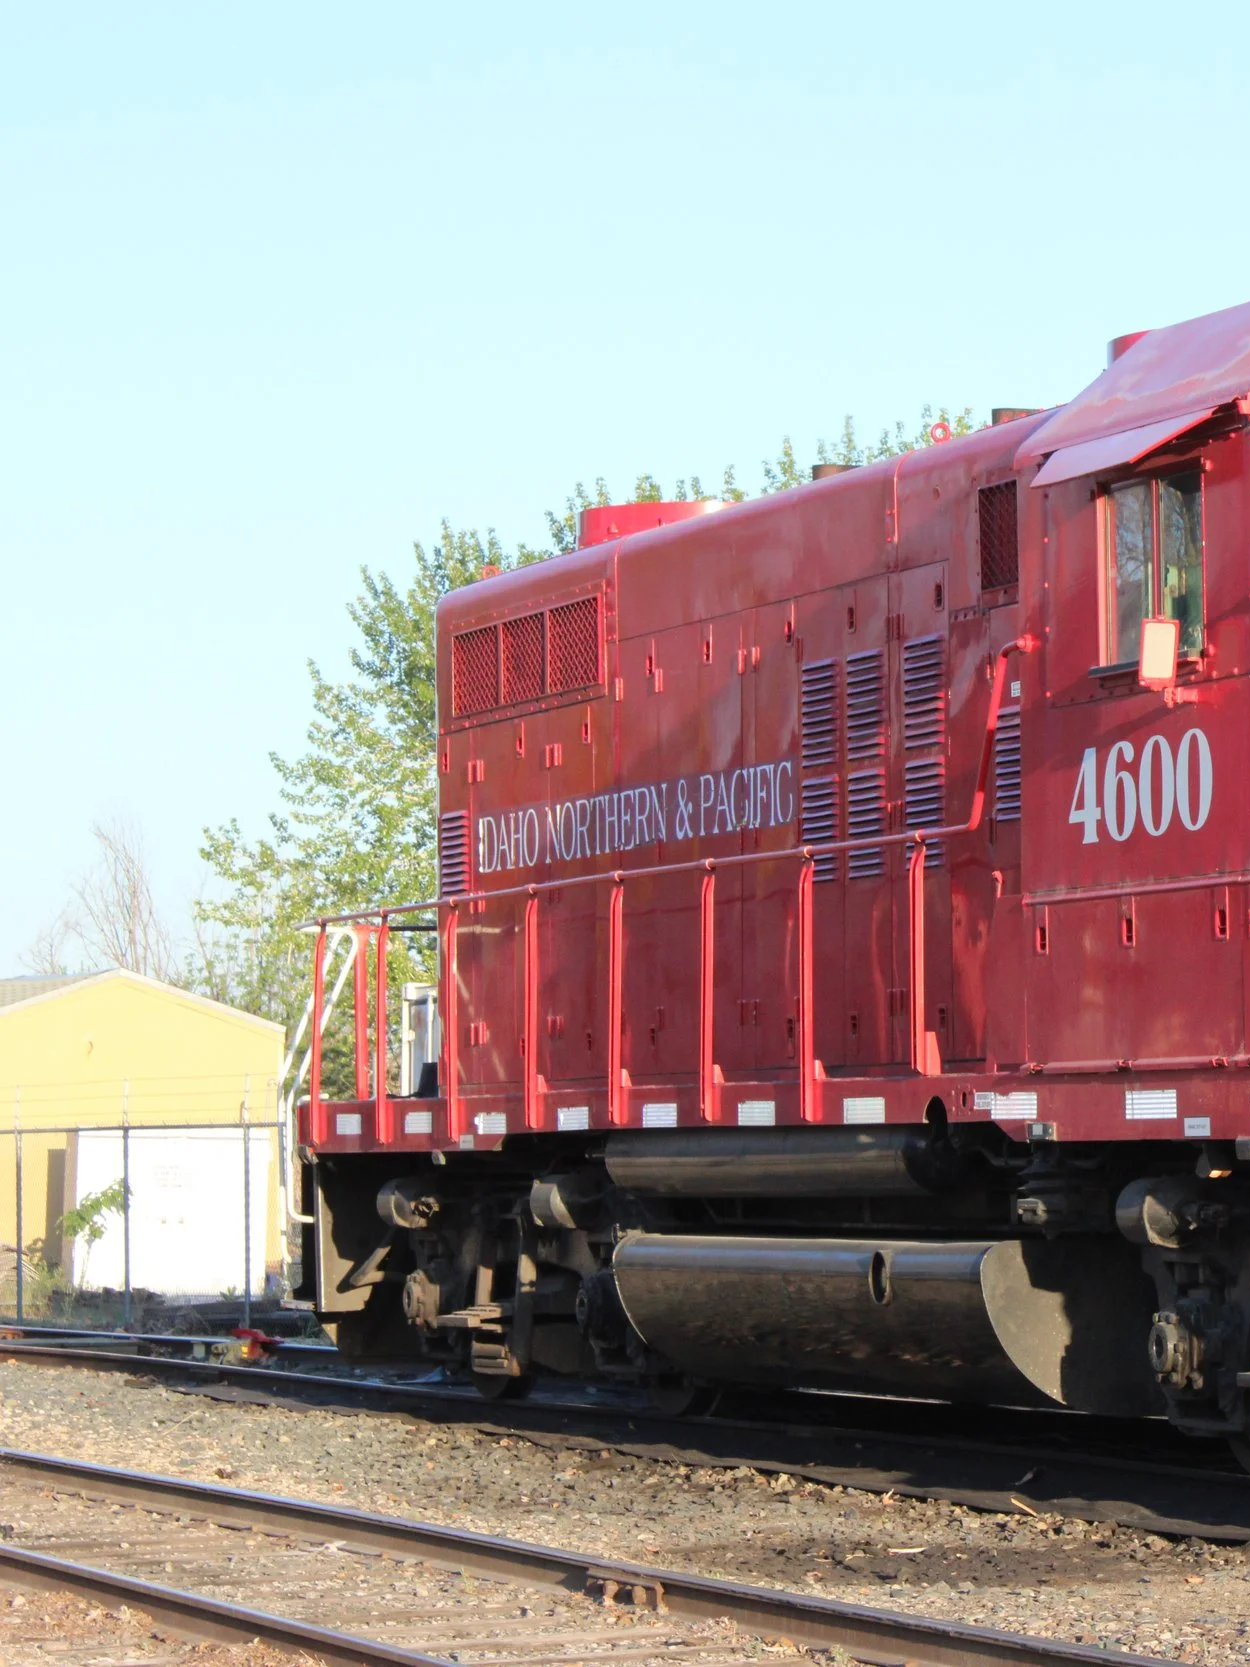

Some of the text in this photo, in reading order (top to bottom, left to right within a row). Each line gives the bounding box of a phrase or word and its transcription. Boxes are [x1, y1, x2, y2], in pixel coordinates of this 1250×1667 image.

[478, 760, 793, 873] IDAHO NORTHERN & PACIFIC
[1068, 728, 1214, 845] 4600
